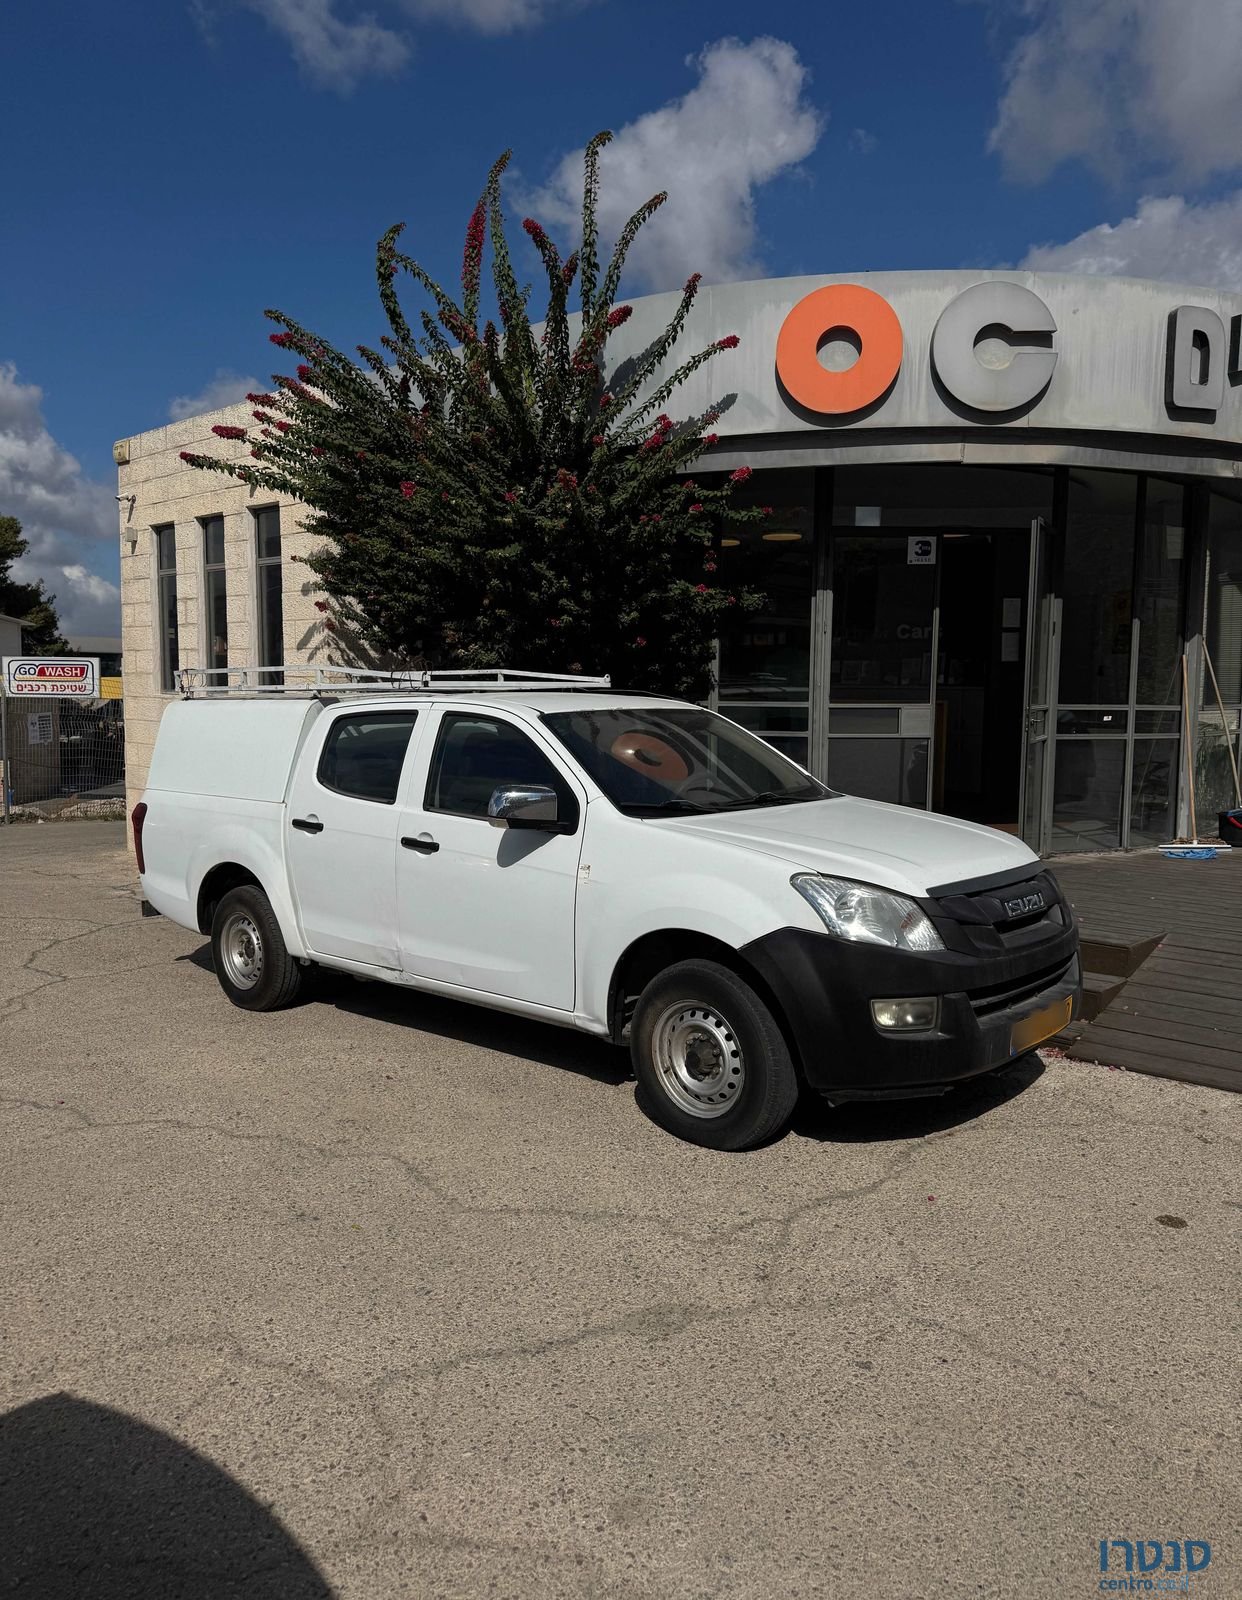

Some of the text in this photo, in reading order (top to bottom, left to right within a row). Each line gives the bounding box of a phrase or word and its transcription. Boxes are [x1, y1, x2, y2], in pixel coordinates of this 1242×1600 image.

[19, 667, 80, 677] GO WASH
[16, 683, 87, 693] שטיפת רכבים
[1005, 893, 1044, 916] ISUZU
